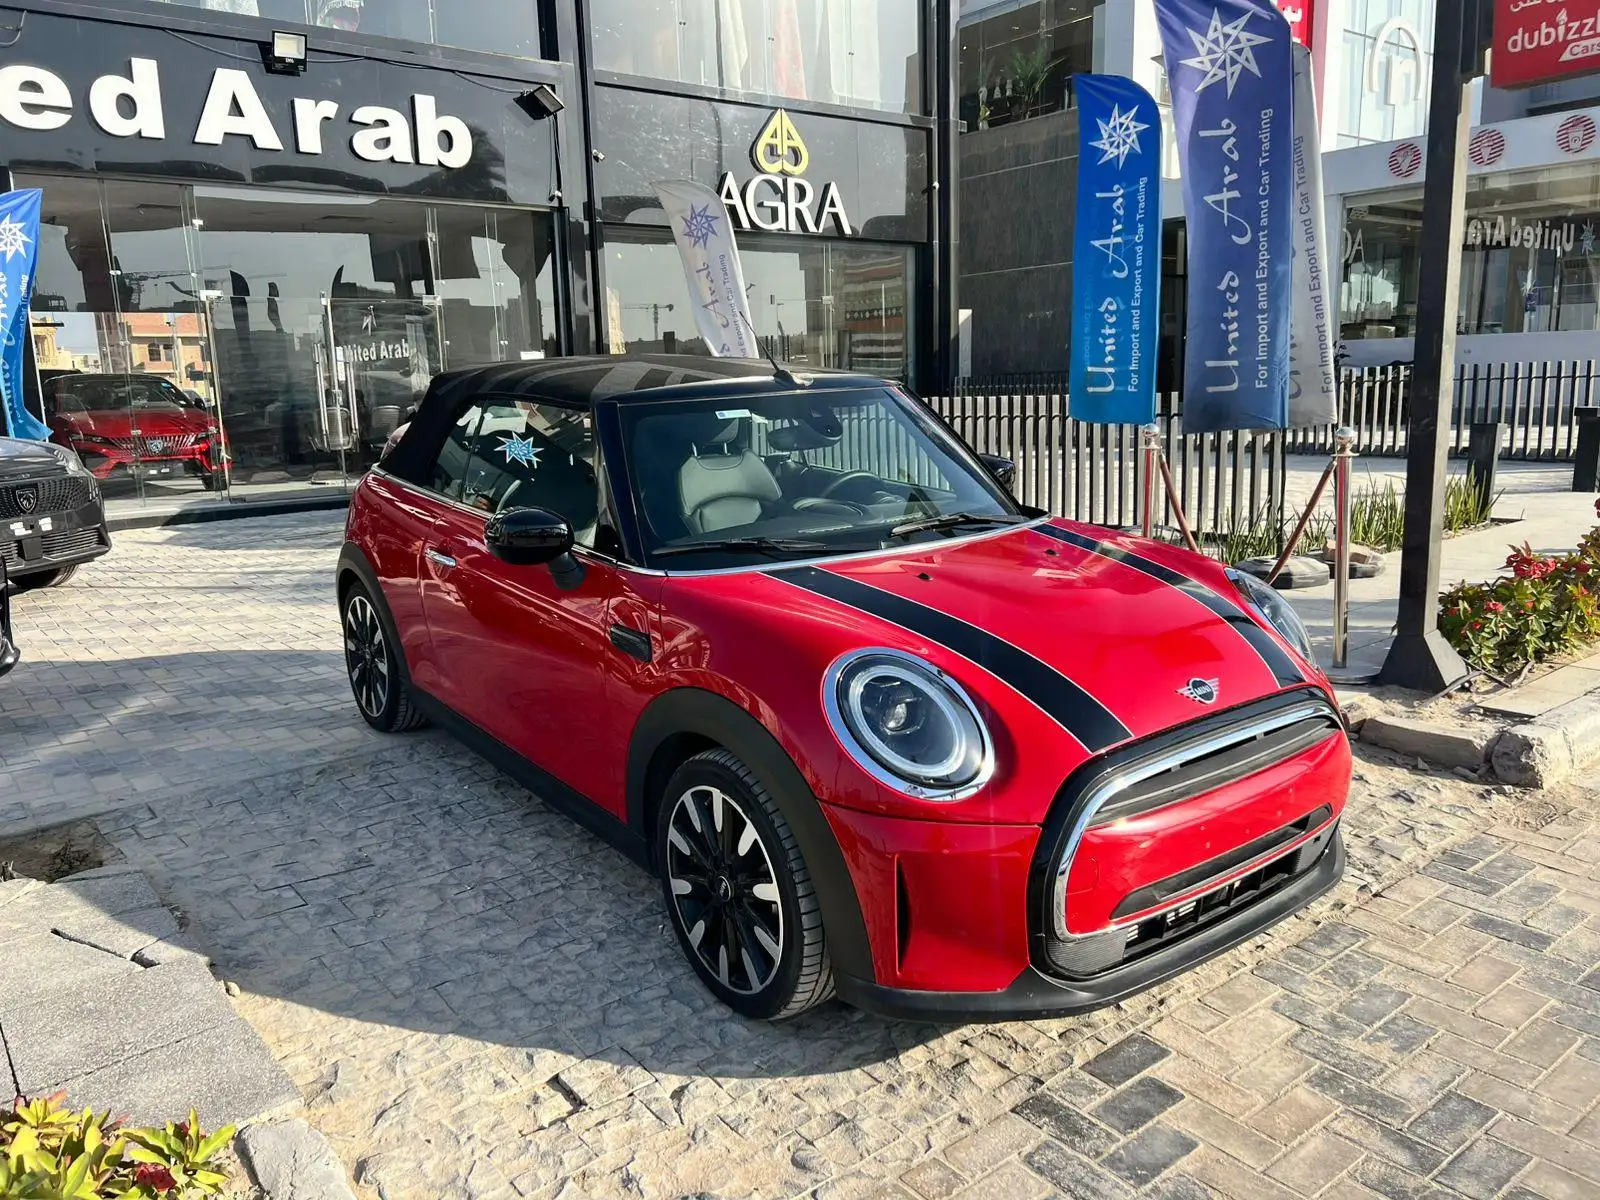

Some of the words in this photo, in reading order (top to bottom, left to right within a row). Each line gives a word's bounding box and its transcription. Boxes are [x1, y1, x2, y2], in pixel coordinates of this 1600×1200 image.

[1570, 42, 1600, 57] Cars
[194, 66, 474, 170] Arab
[1259, 108, 1273, 168] Trading
[1294, 136, 1306, 190] Trading
[1198, 118, 1252, 245] Arab
[1259, 170, 1270, 196] Car
[720, 171, 852, 235] AGRA
[1136, 177, 1148, 222] Trading
[1259, 199, 1269, 227] and
[1299, 191, 1311, 216] Car
[1090, 183, 1129, 279] Arab
[1135, 221, 1145, 242] Car
[1301, 218, 1315, 243] and
[718, 254, 730, 285] Trading
[1256, 230, 1271, 279] Export
[1306, 247, 1321, 292] Export
[695, 262, 730, 329] Arab
[1132, 269, 1143, 307] Export
[1256, 285, 1268, 309] and
[1132, 308, 1140, 331] and
[1310, 296, 1325, 321] and
[380, 338, 410, 359] Arab
[1129, 331, 1141, 371] Import
[1255, 313, 1271, 362] Import
[1315, 323, 1329, 368] Import
[1128, 371, 1139, 392] For
[1255, 365, 1268, 389] For
[1321, 370, 1334, 394] For
